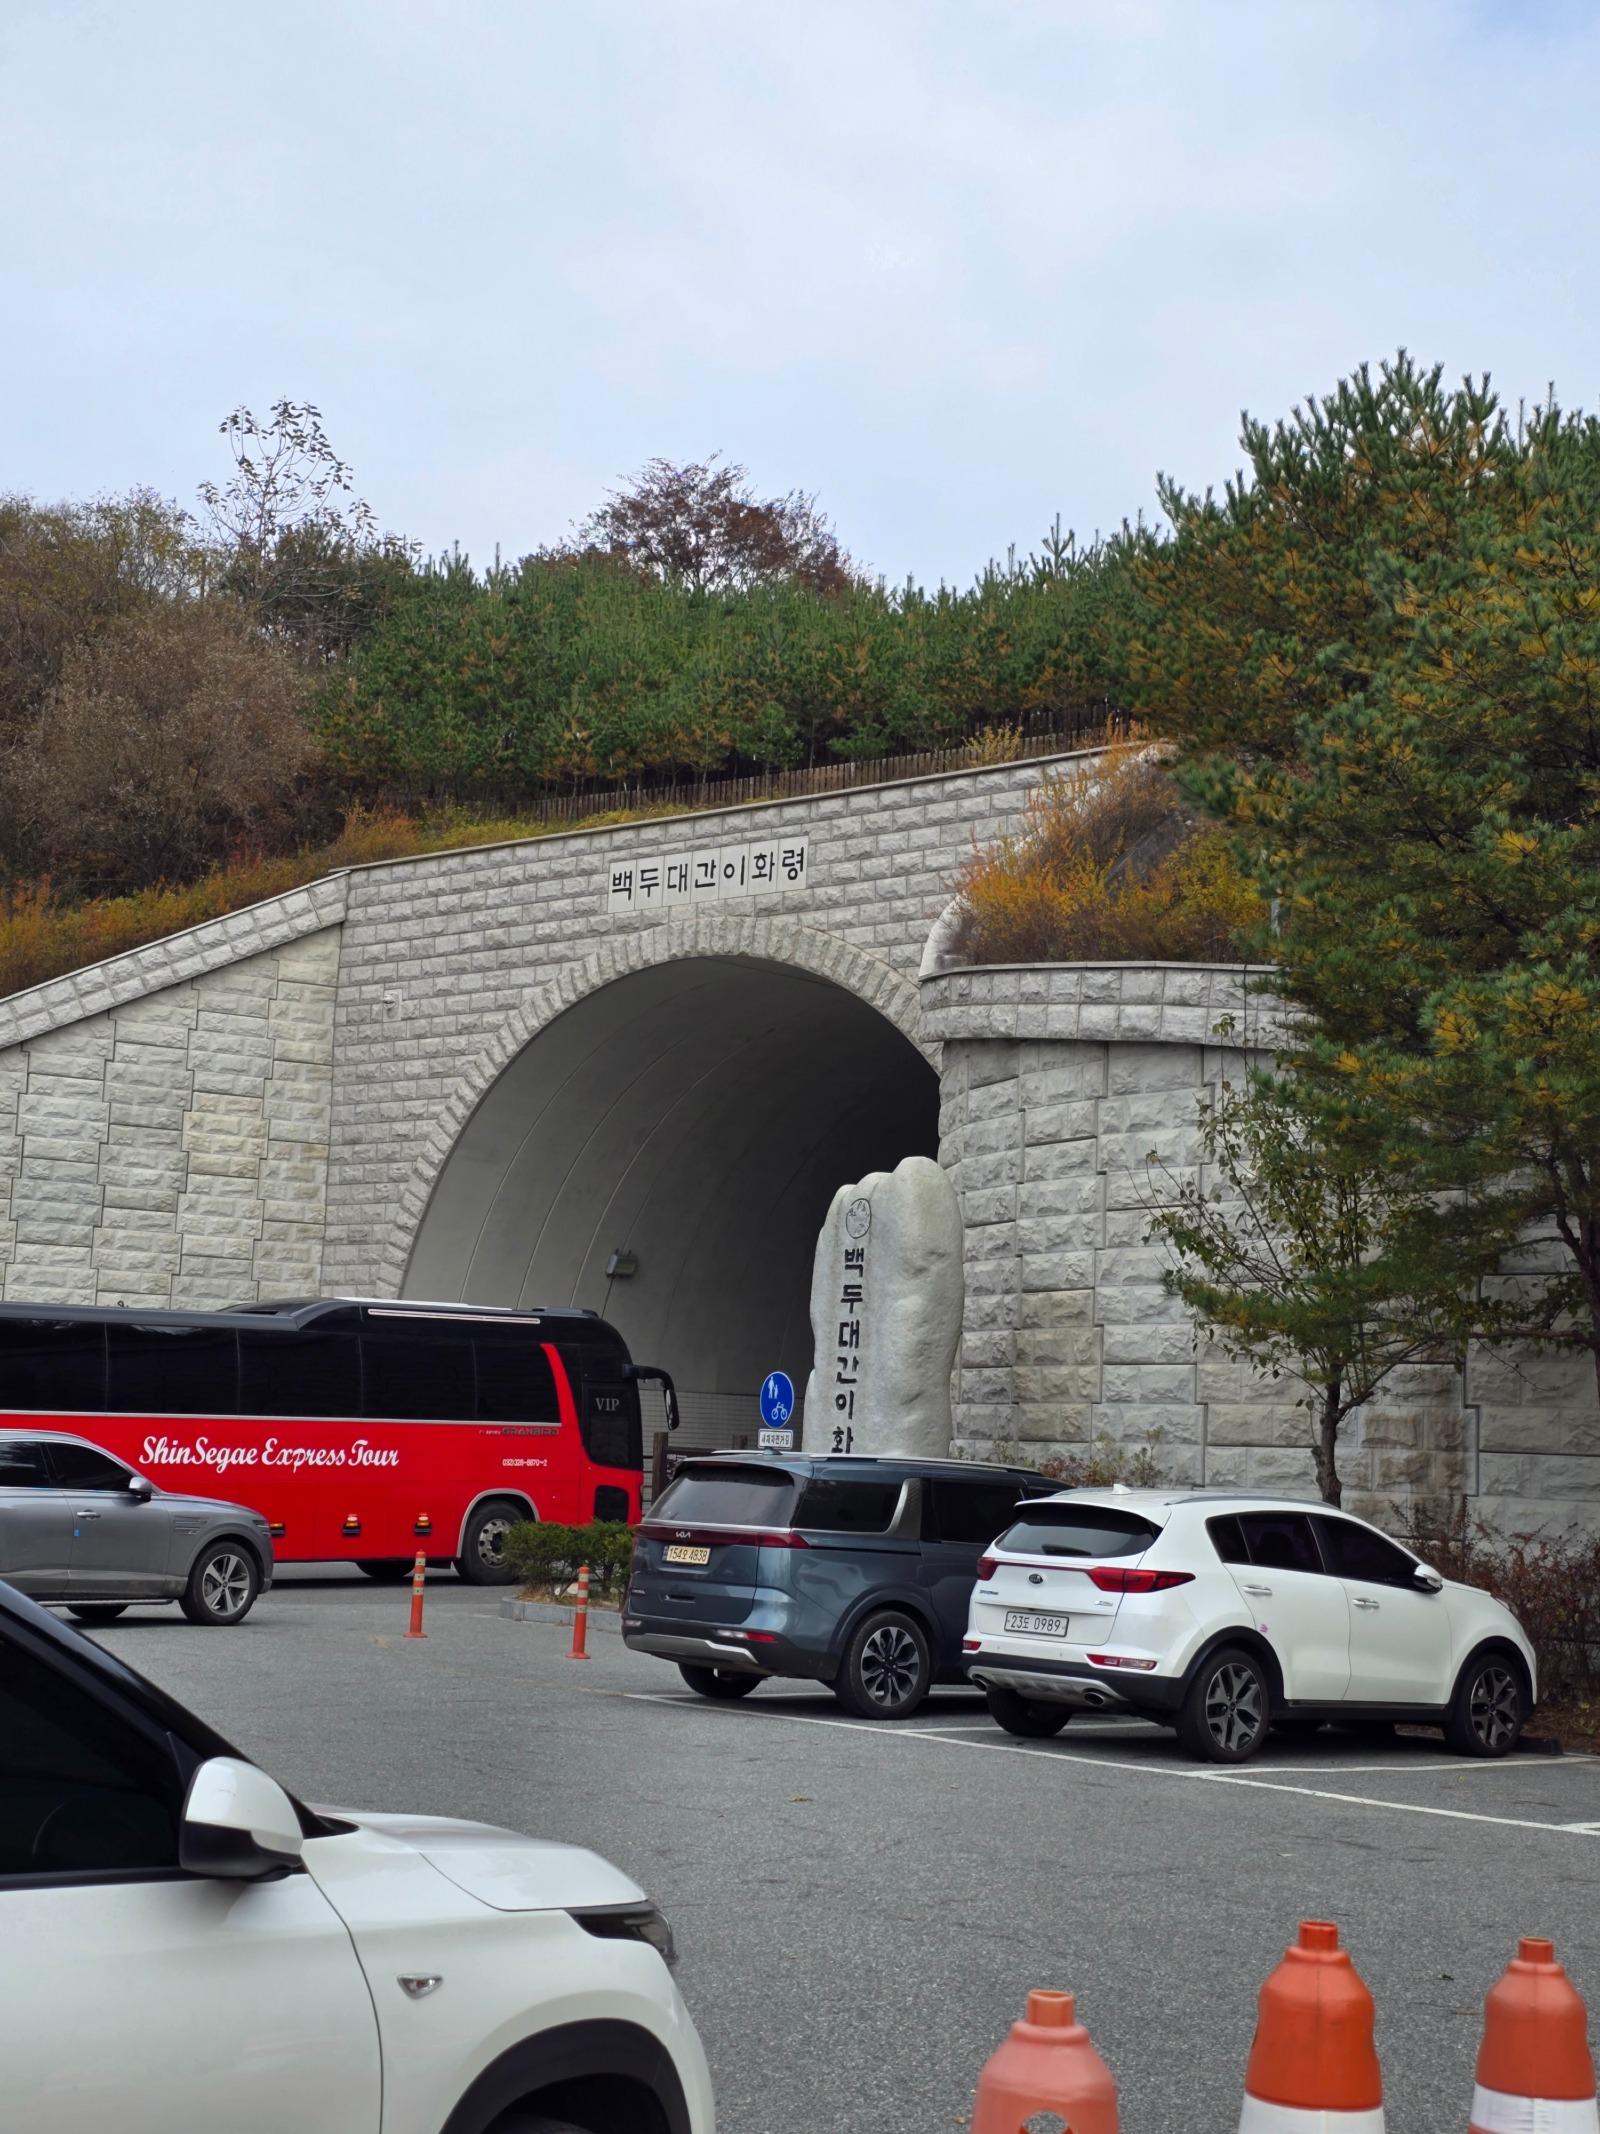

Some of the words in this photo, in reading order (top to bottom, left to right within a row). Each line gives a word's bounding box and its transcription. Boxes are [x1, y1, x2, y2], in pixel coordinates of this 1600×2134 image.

[611, 846, 805, 901] 백두대간이화령
[595, 1397, 620, 1411] VIP
[139, 1436, 258, 1474] ShinSegae
[261, 1437, 346, 1474] Express
[348, 1439, 400, 1466] Tour
[689, 1549, 708, 1562] 4838
[1010, 1614, 1030, 1629] 23도
[1033, 1617, 1061, 1632] 0989
